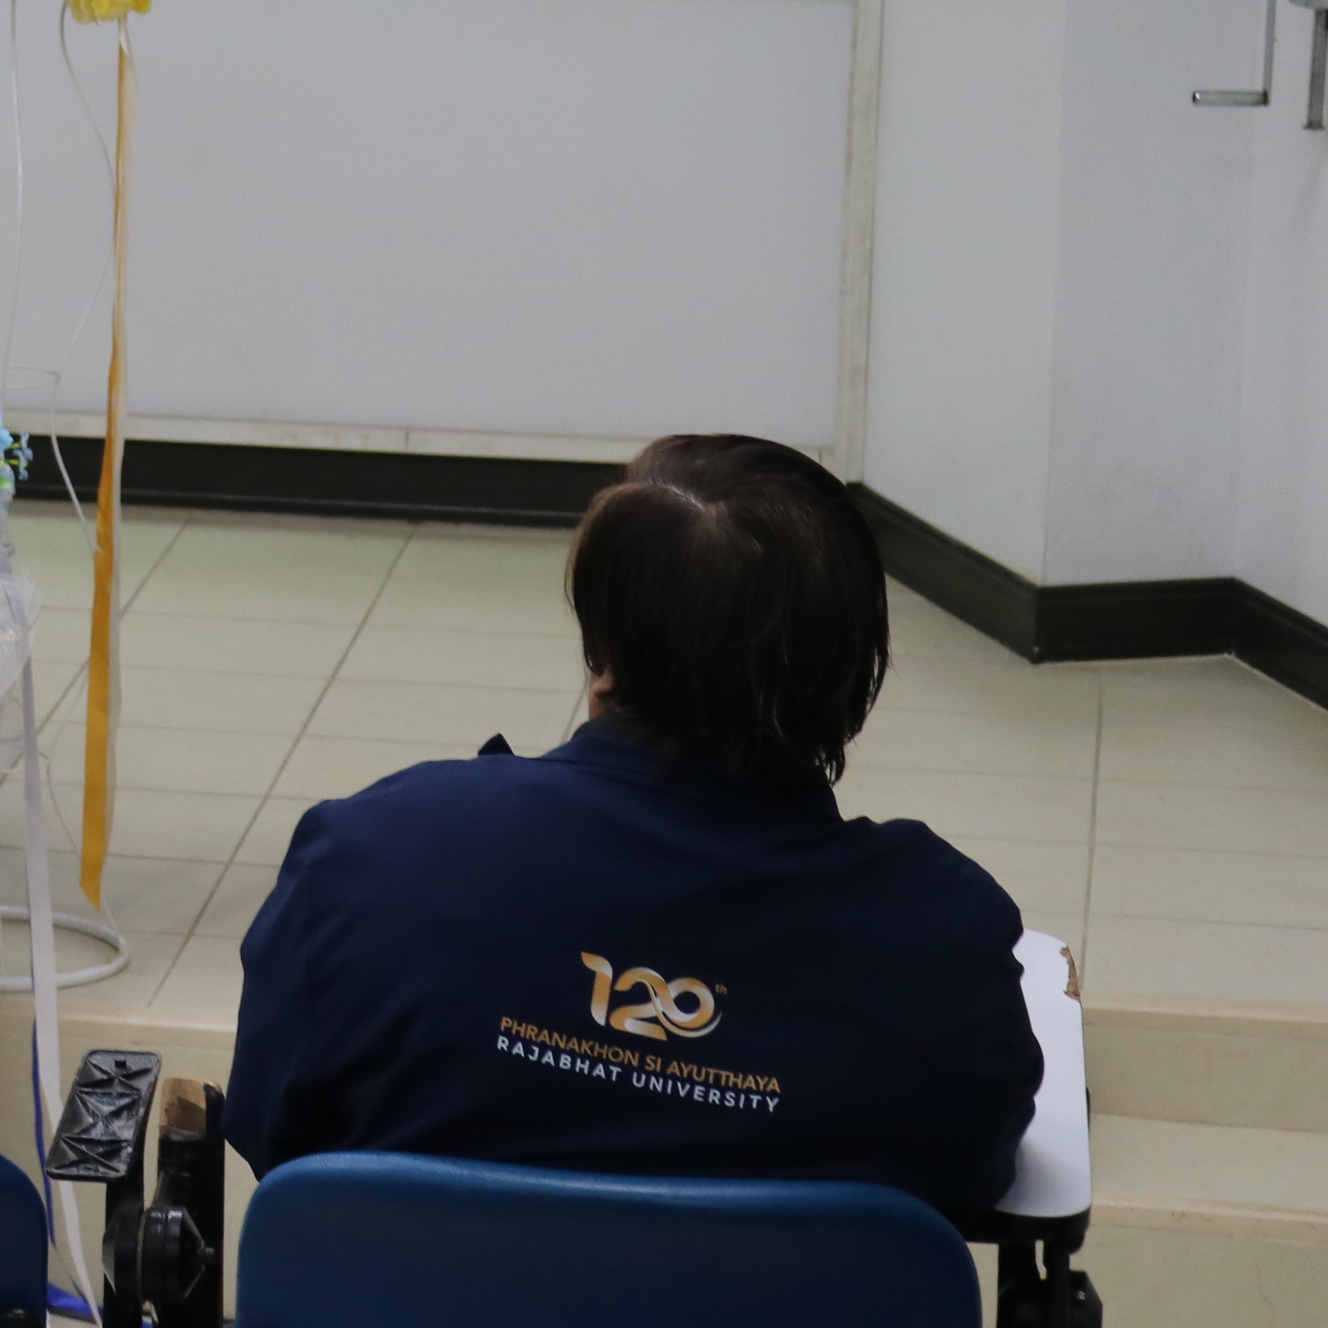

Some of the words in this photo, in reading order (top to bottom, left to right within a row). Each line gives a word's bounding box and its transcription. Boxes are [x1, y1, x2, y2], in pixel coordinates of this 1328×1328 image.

[496, 1034, 623, 1083] RAJABHAT
[632, 1072, 780, 1114] UNIVERSITY
[499, 1015, 639, 1068] PHRANAKHON
[644, 1054, 662, 1073] SI
[666, 1059, 782, 1094] AYUTTHAYA
